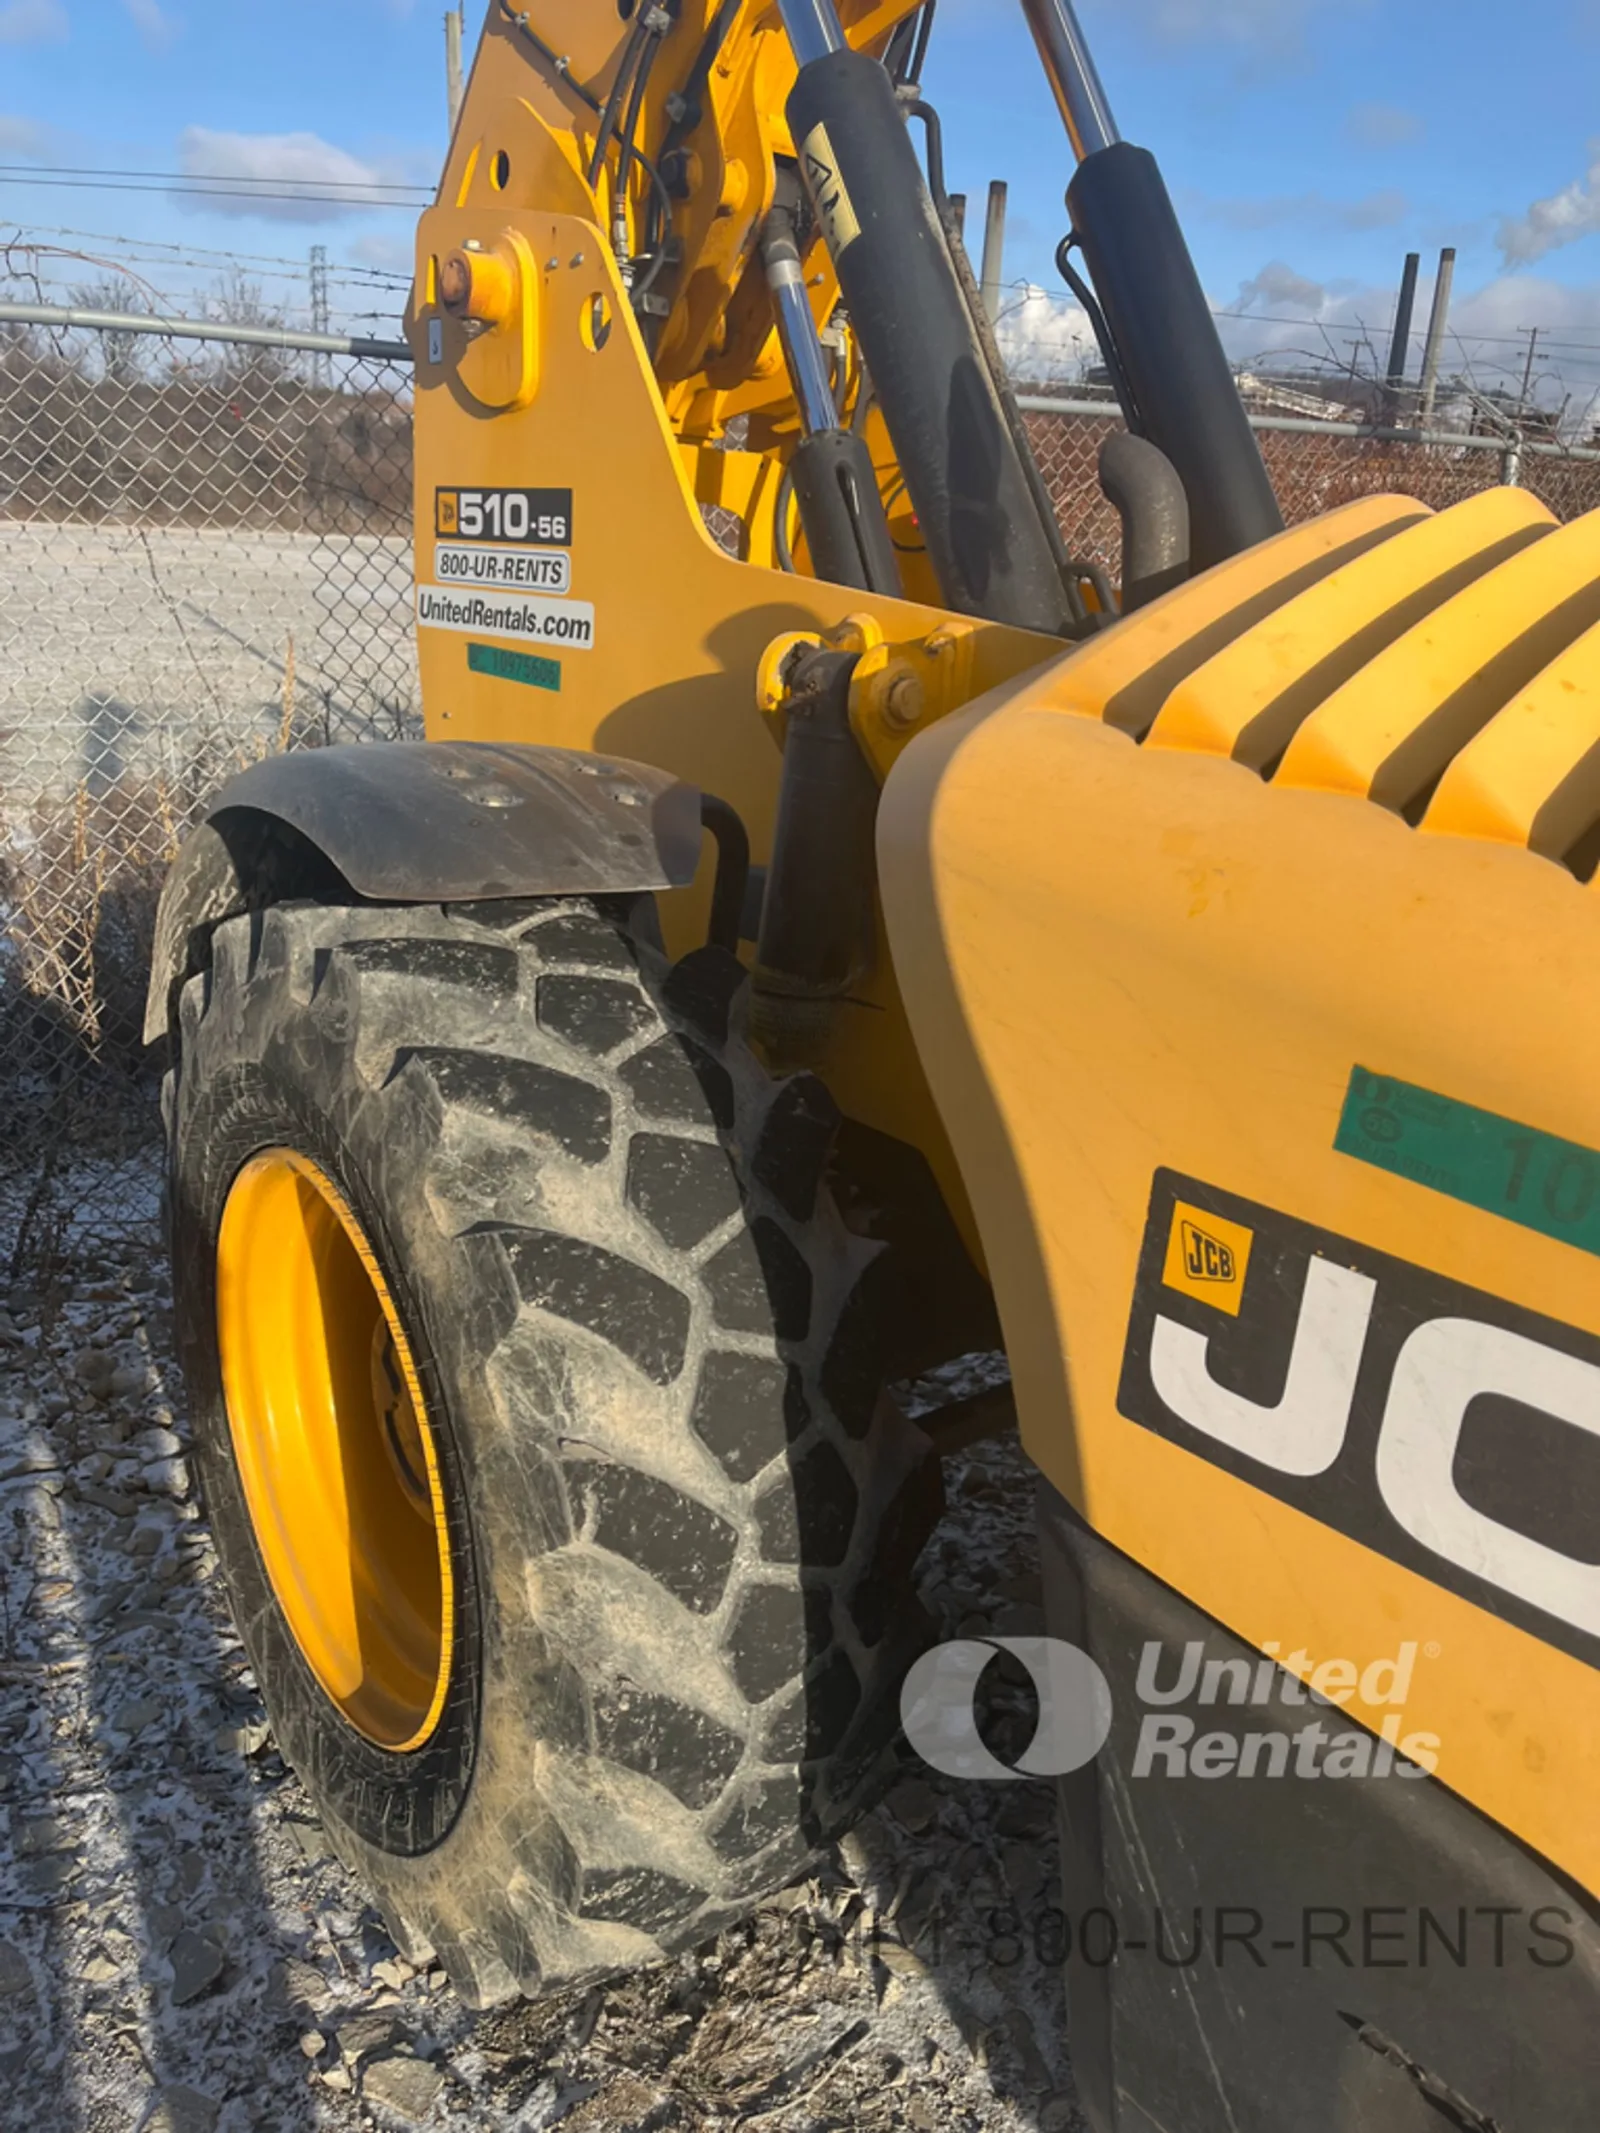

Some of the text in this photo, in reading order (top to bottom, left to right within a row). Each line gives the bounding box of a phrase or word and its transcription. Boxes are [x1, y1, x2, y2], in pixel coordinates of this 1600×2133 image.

[440, 553, 562, 584] 800-UR-RENTS
[420, 594, 591, 641] UnitedRentals.com
[1188, 1231, 1231, 1278] JCB
